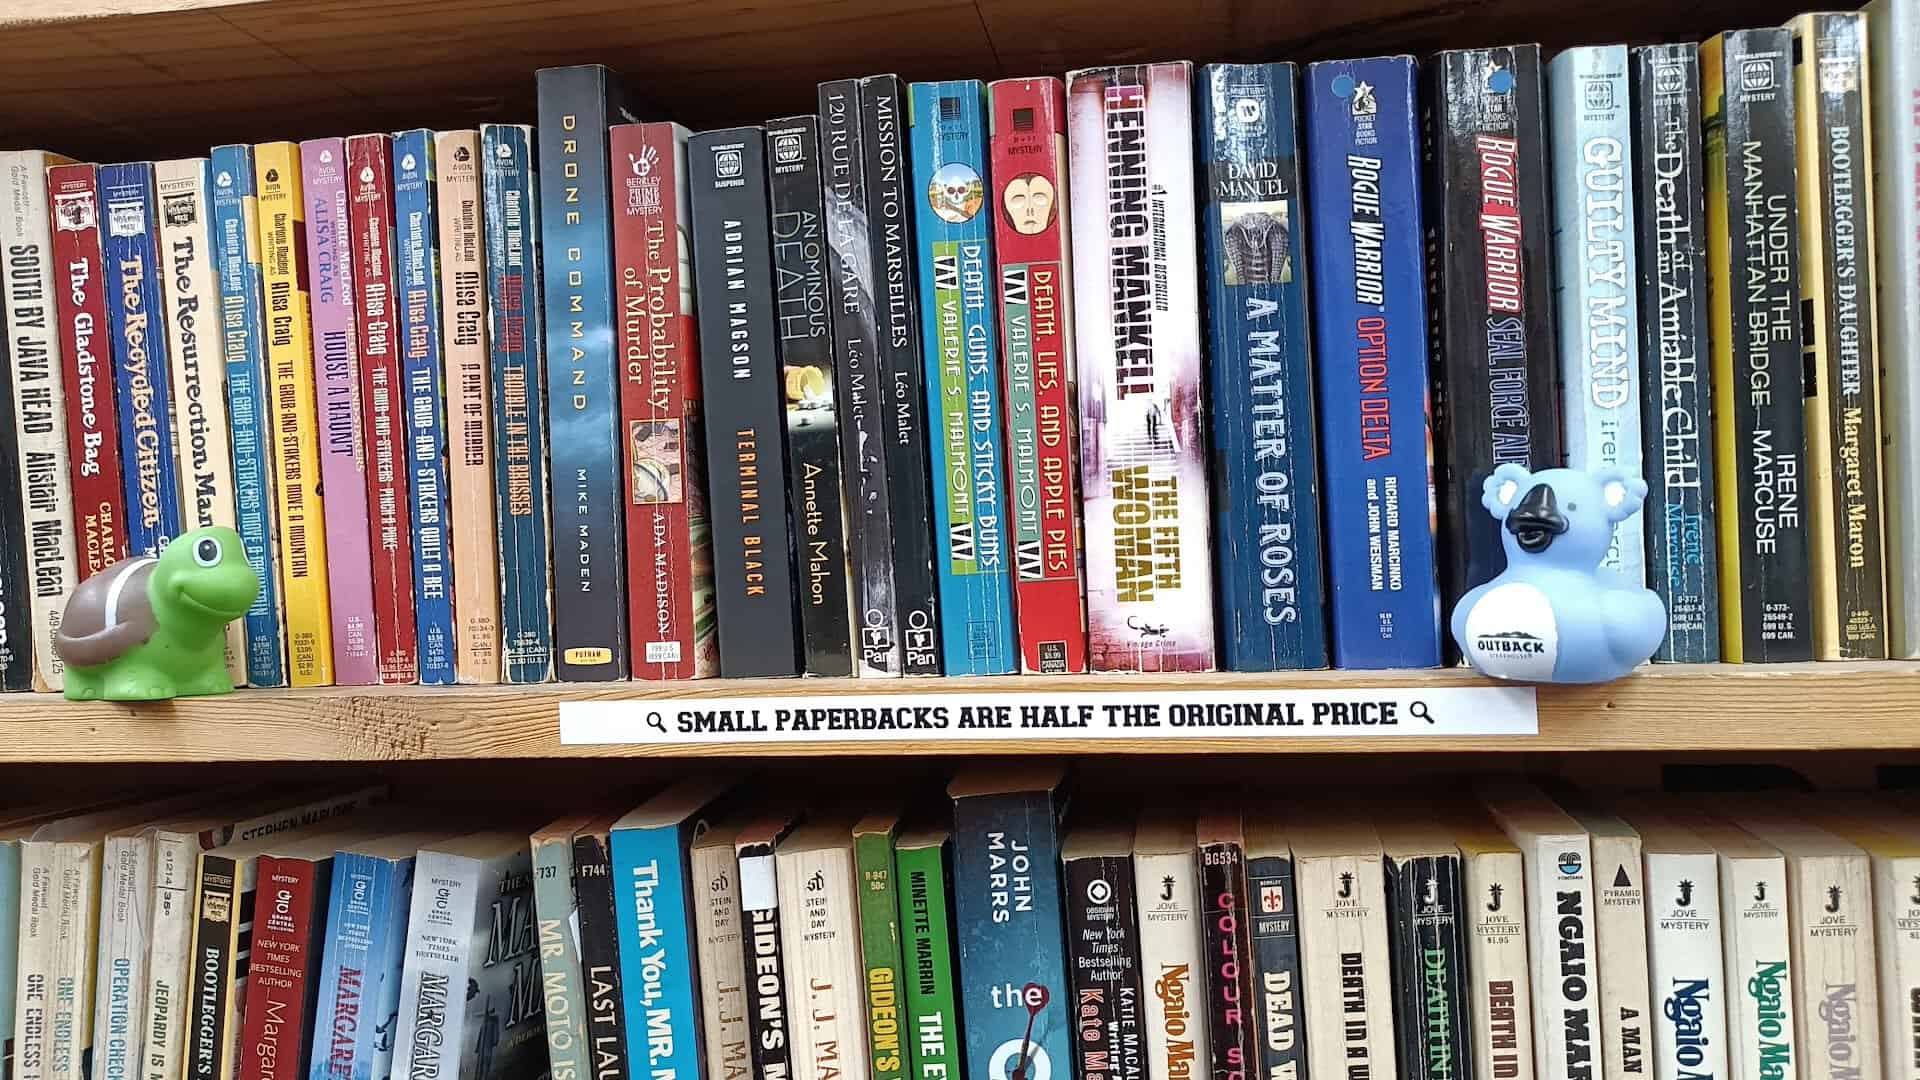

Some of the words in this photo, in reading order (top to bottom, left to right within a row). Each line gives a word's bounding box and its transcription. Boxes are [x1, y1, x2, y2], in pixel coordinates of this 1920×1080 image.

[830, 130, 850, 176] RUE
[875, 96, 896, 182] MISSION
[1104, 85, 1149, 238] HENNING
[562, 115, 580, 225] DRONE
[1346, 153, 1382, 217] ROGUE
[1476, 136, 1518, 207] ROGUE
[1654, 150, 1690, 244] Death
[314, 197, 331, 246] ALISA
[881, 186, 900, 218] TO
[1583, 136, 1626, 289] GUILTY
[1743, 141, 1765, 304] MANHATTAN
[1829, 125, 1856, 279] BOOTLEGGER'S
[173, 237, 195, 293] The
[646, 221, 664, 260] The
[723, 220, 746, 290] ADRIAN
[1766, 194, 1790, 284] UNDER
[9, 245, 42, 300] SOUTH
[69, 257, 88, 305] The
[121, 255, 142, 310] The
[318, 251, 335, 304] CRAIG
[340, 250, 352, 305] MacLeod
[455, 271, 480, 306] Alisa
[804, 242, 826, 337] OMINOUS
[883, 223, 907, 349] MARSEILLES
[15, 307, 45, 329] BY
[272, 316, 292, 346] Craig
[455, 311, 481, 346] Craig
[568, 248, 586, 410] COMMAND
[1111, 245, 1154, 401] MANKELL
[1246, 297, 1279, 320] A
[1771, 290, 1792, 342] THE
[16, 336, 50, 382] JAVA
[367, 322, 388, 354] Craig
[408, 325, 429, 358] Craig
[624, 296, 647, 385] Murder
[648, 266, 675, 412] Probability
[728, 302, 751, 380] MAGSON
[1356, 316, 1388, 393] OPTION
[1588, 295, 1631, 410] MIND
[1748, 313, 1771, 406] BRIDGE
[1837, 285, 1861, 397] DAUGHTER
[73, 312, 98, 428] Gladstone
[124, 313, 155, 429] Recycled
[177, 295, 210, 470] Resurrection
[327, 387, 349, 396] A
[412, 368, 431, 393] THE
[1247, 330, 1287, 462] MATTER
[21, 389, 53, 434] HEAD
[464, 403, 482, 416] OF
[507, 422, 528, 435] IN
[971, 390, 991, 432] AND
[1015, 402, 1028, 418] S.
[1041, 405, 1062, 447] AND
[1359, 398, 1392, 462] DELTA
[81, 431, 102, 477] Bag
[948, 411, 969, 517] MALMONT
[974, 439, 997, 505] STICKY
[1663, 407, 1700, 489] Child
[1839, 407, 1864, 498] Margaret
[26, 452, 59, 512] Alistair
[136, 430, 160, 529] Citizen
[577, 469, 589, 514] MIKE
[736, 428, 761, 524] TERMINAL
[803, 463, 823, 536] Annette
[1017, 428, 1038, 535] MALMONT
[1044, 457, 1066, 521] APPLE
[1152, 475, 1179, 520] THE
[1256, 471, 1290, 513] OF
[1366, 478, 1379, 500] and
[1384, 477, 1399, 528] RICHARD
[1752, 430, 1775, 555] MARCUSE
[1776, 454, 1798, 529] IRENE
[653, 512, 666, 547] ADA
[978, 515, 1001, 567] BUNS
[1111, 464, 1154, 603] WOMAN
[1367, 502, 1381, 533] JOHN
[1847, 503, 1866, 569] Maron
[579, 524, 591, 593] MADEN
[743, 536, 765, 597] BLACK
[807, 541, 830, 605] Mahon
[1047, 529, 1068, 571] PIES
[1153, 526, 1182, 590] FIFTH
[1258, 523, 1297, 626] ROSES
[1369, 536, 1384, 591] WEISMAN
[1386, 529, 1402, 591] MARCINKO
[1477, 640, 1545, 653] OUTBACK
[677, 710, 768, 733] SMALL
[775, 707, 949, 732] PAPERBACKS
[958, 706, 1012, 728] ARE
[1020, 705, 1095, 728] HALF
[1102, 704, 1161, 728] THE
[1169, 703, 1304, 727] ORIGINAL
[1311, 702, 1398, 726] PRICE
[271, 874, 299, 884] MYSTERY
[431, 878, 461, 888] MYSTERY
[632, 858, 664, 948] Thank
[710, 897, 732, 906] STEIN
[805, 897, 827, 908] STEIN
[910, 871, 930, 934] MINETTE
[987, 831, 1010, 924] MARRS
[1012, 840, 1032, 912] JOHN
[1603, 889, 1640, 898] PYRAMID
[1604, 898, 1641, 906] MYSTERY
[714, 907, 730, 917] AND
[715, 919, 729, 927] DAY
[809, 908, 826, 917] AND
[811, 919, 826, 928] DAY
[1147, 912, 1189, 922] MYSTERY
[1156, 902, 1178, 910] JOVE
[1258, 920, 1290, 933] MYSTERY
[1476, 926, 1520, 934] MYSTERY
[1486, 915, 1510, 923] JOVE
[1661, 921, 1710, 931] MYSTERY
[1670, 909, 1697, 918] JOVE
[1744, 911, 1778, 919] MYSTERY
[1810, 927, 1857, 937] MYSTERY
[1819, 915, 1846, 925] JOVE
[257, 939, 278, 949] NEW
[278, 941, 300, 953] YORK
[267, 953, 290, 964] TIMES
[1082, 928, 1103, 941] New
[1106, 927, 1125, 940] York
[1092, 942, 1119, 954] Times
[1556, 891, 1588, 1002] NGAIO
[258, 977, 293, 989] AUTHOR
[639, 948, 668, 1007] You,
[916, 937, 935, 996] MARRIN
[1079, 956, 1132, 968] Bestselling
[1090, 969, 1121, 982] Author
[1340, 952, 1365, 1013] DEATH
[151, 979, 170, 1048] JEOPARDY
[197, 947, 220, 1074] BOOTLEGGER'S
[543, 972, 573, 1050] MOTO
[589, 964, 617, 1026] LAST
[868, 967, 901, 1072] GIDEON'S
[990, 983, 1043, 1009] the
[1079, 989, 1105, 1041] Kate
[1119, 987, 1135, 1028] KATIE
[1155, 962, 1190, 1036] Ngaio
[1263, 971, 1295, 1052] DEAD
[1488, 981, 1517, 1049] DEATH
[1663, 976, 1710, 1067] Ngaio
[1747, 960, 1787, 1038] Ngaio
[23, 1008, 43, 1068] ENDLESS
[646, 1008, 675, 1066] MR.
[918, 1011, 945, 1057] THE
[1346, 1046, 1368, 1059] A
[1621, 1027, 1643, 1073] MAN
